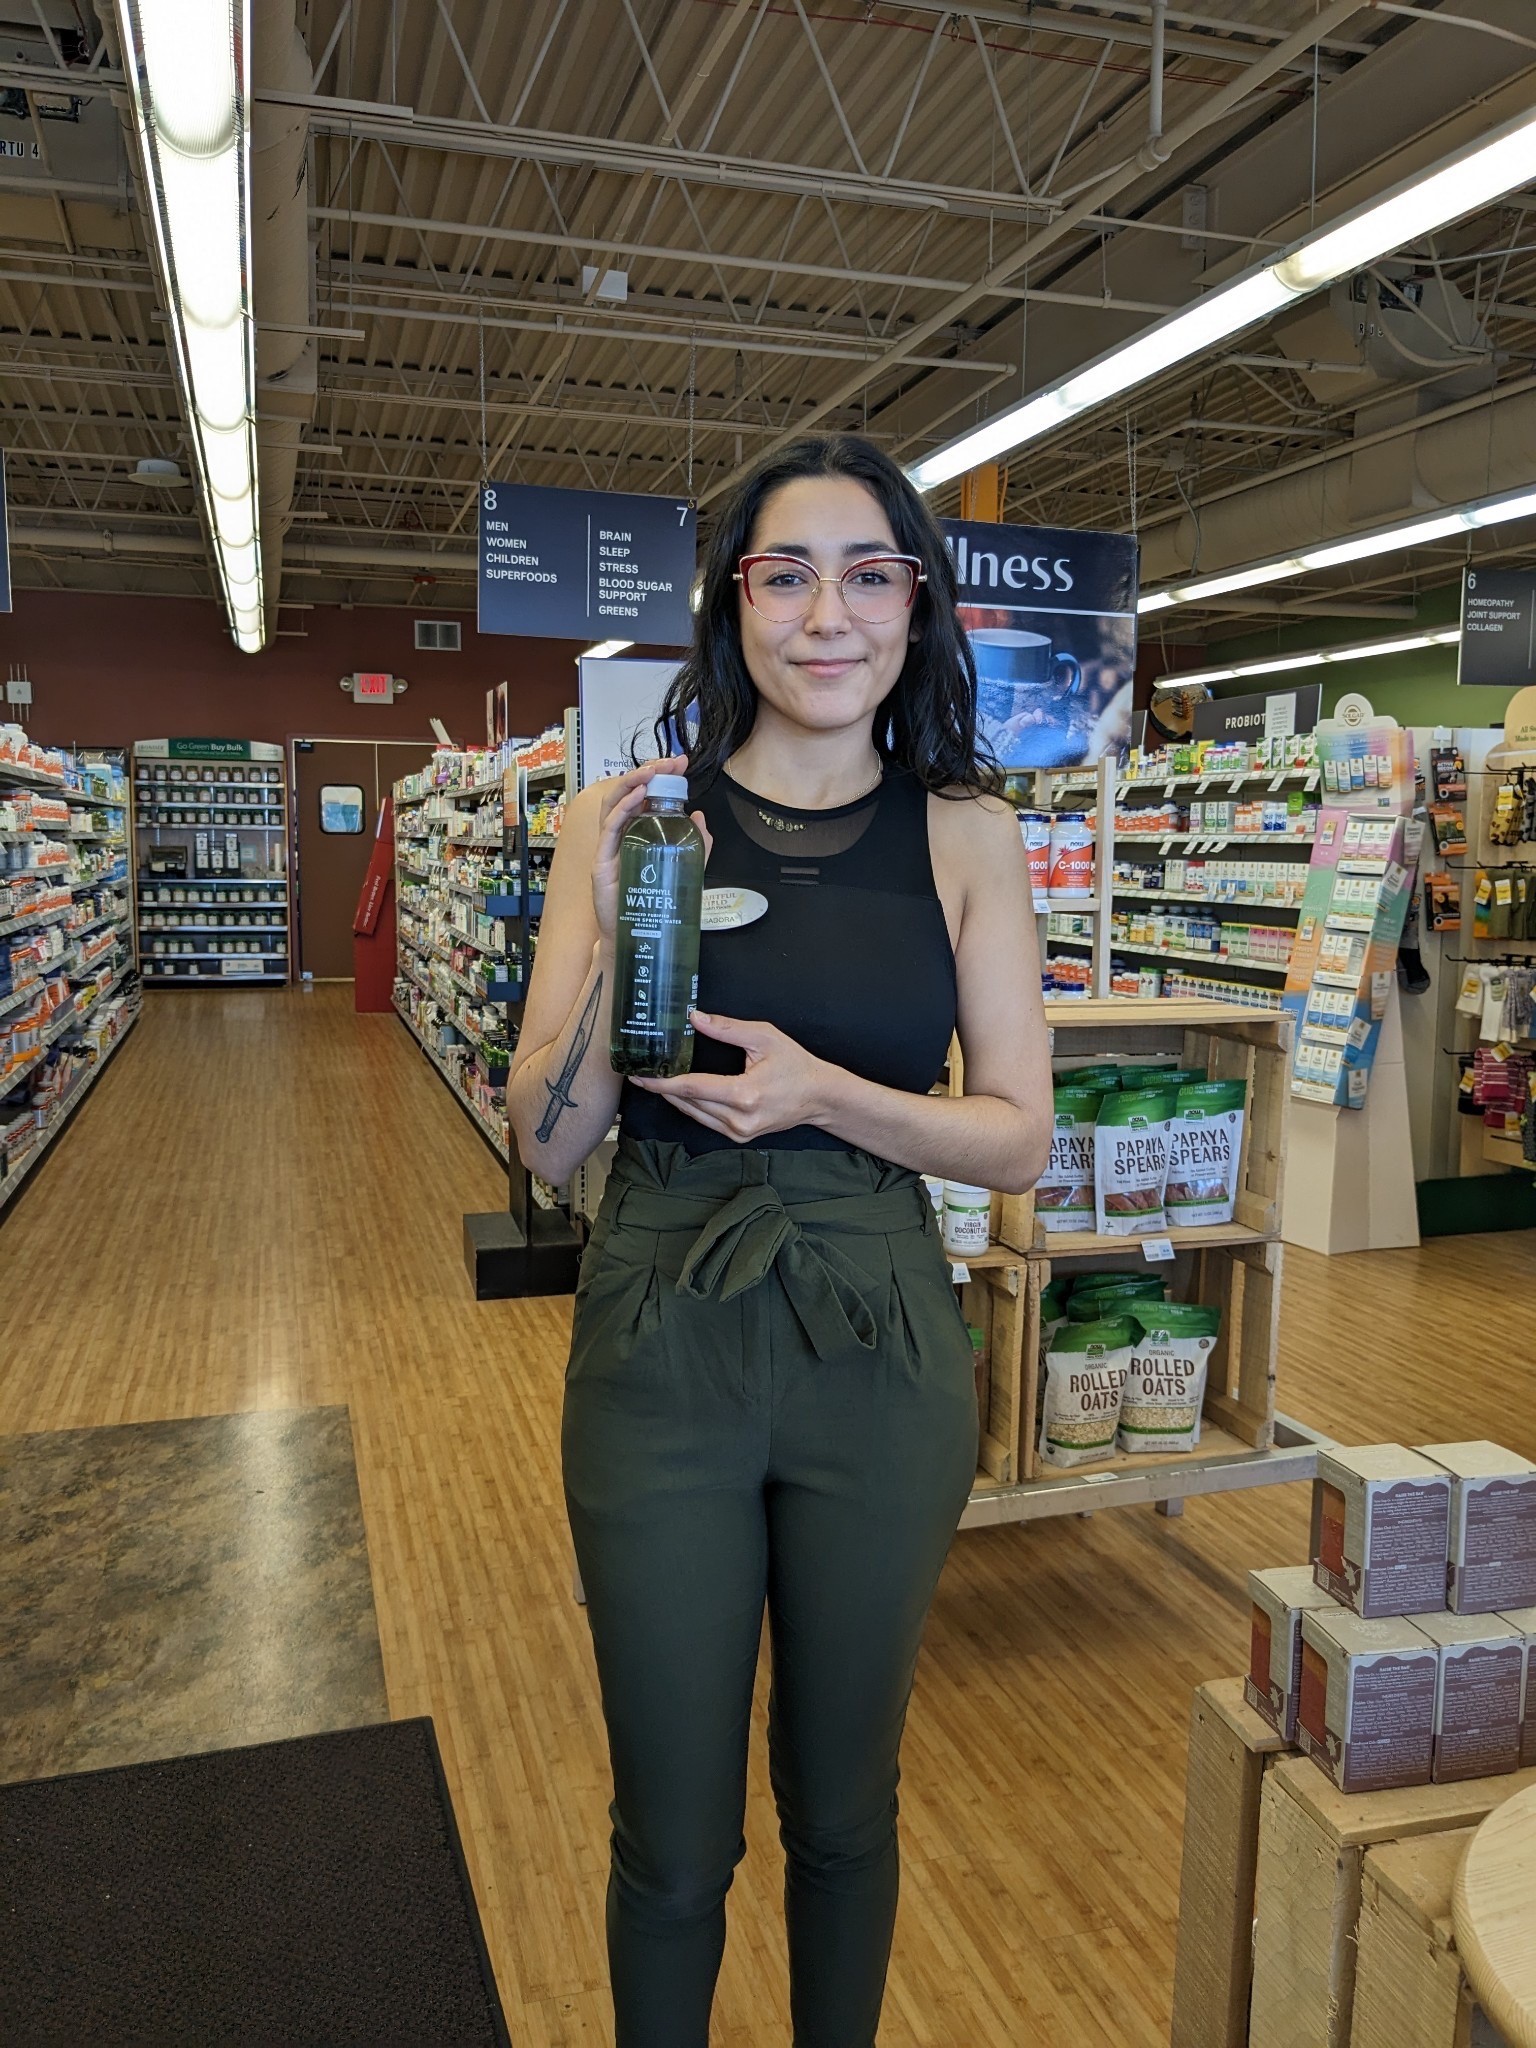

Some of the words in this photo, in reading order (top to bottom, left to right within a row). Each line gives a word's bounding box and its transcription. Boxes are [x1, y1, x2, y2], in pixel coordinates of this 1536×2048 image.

[0, 141, 24, 157] RTU
[32, 143, 39, 158] 4
[483, 489, 498, 511] 8
[676, 506, 689, 527] 7
[486, 520, 509, 532] MEN
[486, 537, 527, 549] WOMEN
[599, 531, 632, 543] BRAIN
[486, 553, 539, 566] CHILDREN
[599, 546, 631, 558] SLEEP
[599, 562, 639, 574] STRESS
[945, 536, 1074, 592] lness
[486, 569, 558, 584] SUPERFOODS
[1467, 573, 1477, 589] 6
[599, 578, 635, 591] BLOOD
[637, 580, 673, 593] SUGAR
[599, 590, 648, 602] SUPPORT
[1467, 598, 1515, 607] HOMEOPATHY
[599, 605, 639, 617] GREENS
[1467, 611, 1488, 619] JOINT
[1488, 611, 1521, 620] SUPPORT
[1466, 623, 1504, 632] COLLAGEN
[360, 675, 386, 693] EXIT
[1225, 713, 1267, 730] PROBIOT
[176, 742, 187, 750] Go
[188, 742, 210, 751] Green
[210, 743, 226, 752] Buy
[226, 743, 243, 752] Bulk
[1058, 861, 1090, 870] C-1000
[627, 886, 671, 896] CHLOROPHYLL
[1050, 1136, 1095, 1153] APAYA
[1171, 1128, 1229, 1150] PAPAYA
[1116, 1136, 1165, 1158] PAPAYA
[1049, 1153, 1095, 1171] PEAR
[1169, 1144, 1230, 1166] SPEARS
[1114, 1153, 1166, 1175] SPEARS
[955, 1226, 980, 1234] COCONUT
[1084, 1362, 1108, 1371] ORGANIC
[1130, 1357, 1195, 1377] ROLLED
[1070, 1368, 1128, 1393] ROLLED
[1142, 1378, 1186, 1396] OATS
[1081, 1390, 1119, 1411] OATS
